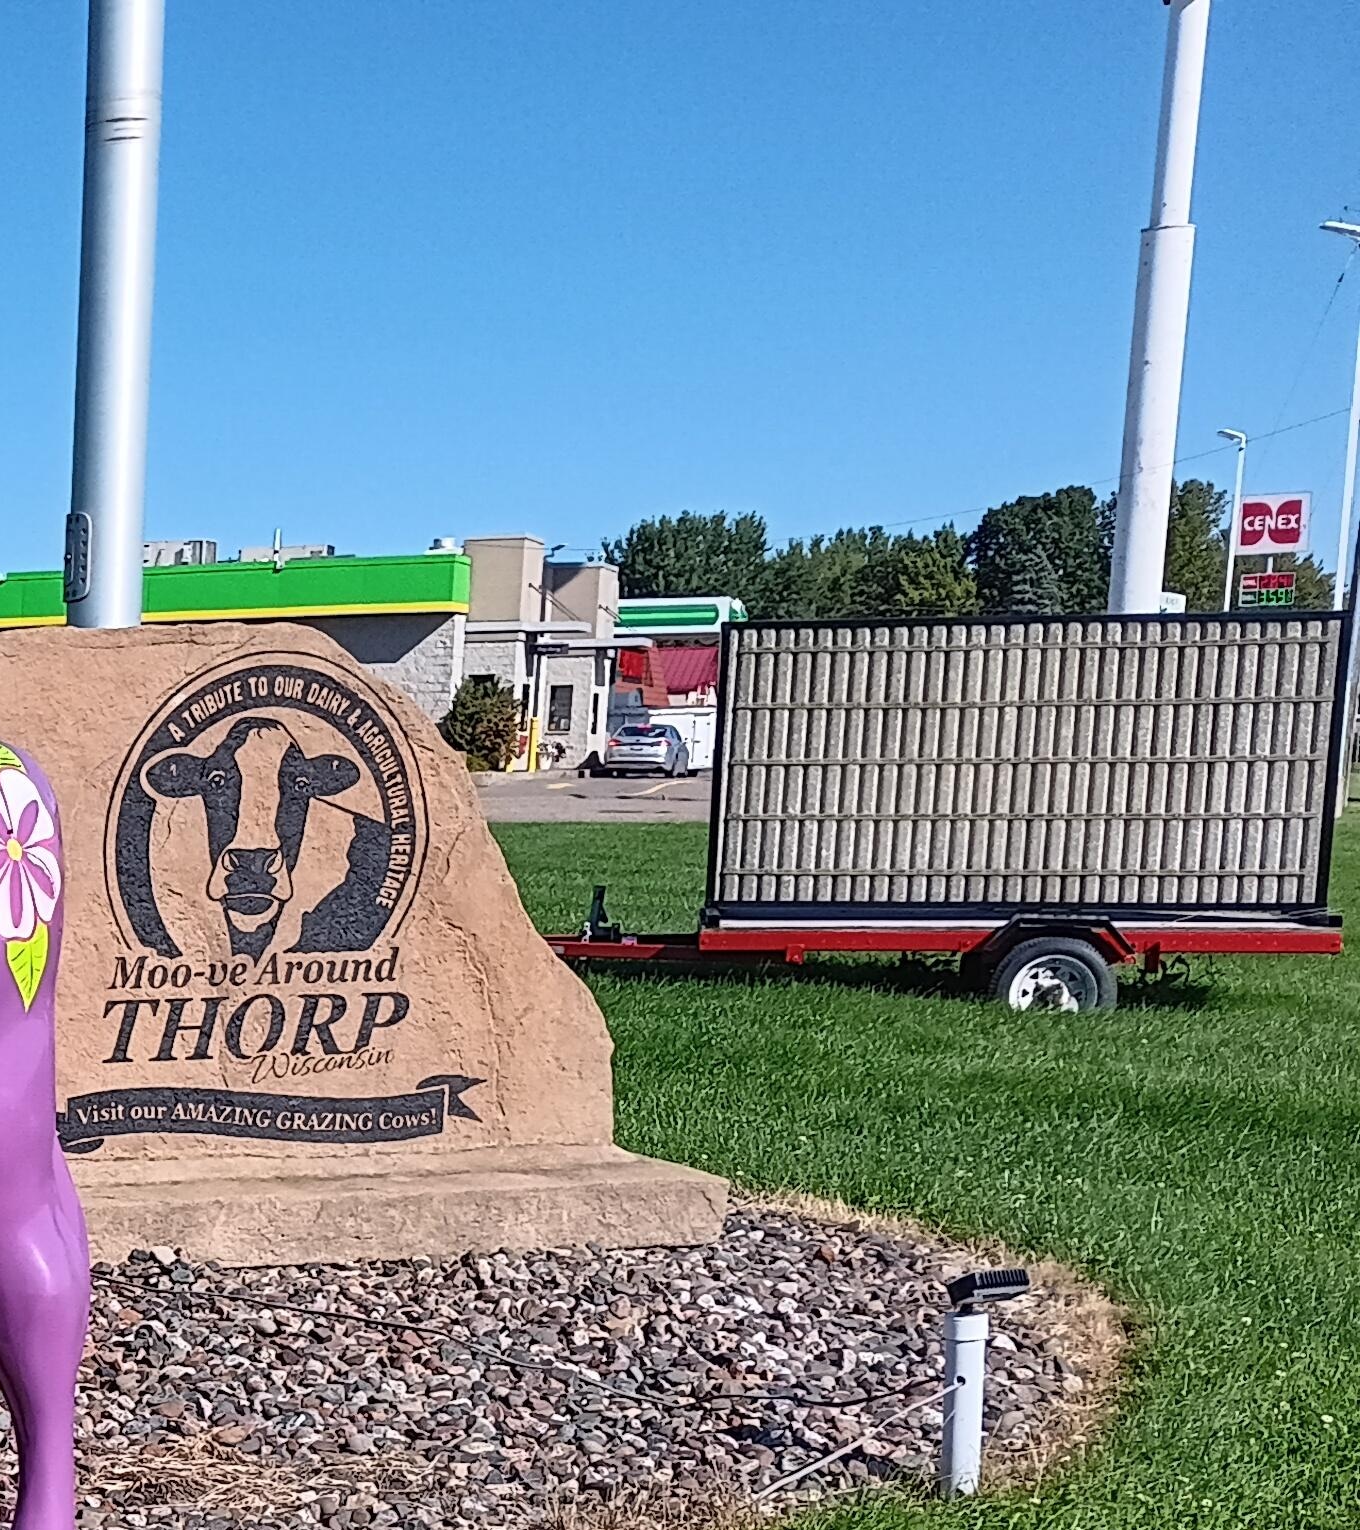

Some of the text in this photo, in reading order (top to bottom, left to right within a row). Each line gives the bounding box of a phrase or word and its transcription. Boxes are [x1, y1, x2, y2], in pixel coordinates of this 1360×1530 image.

[1243, 513, 1300, 532] CENEX
[167, 675, 412, 909] A TRIBUTE TO OUR DAIRY & AGRICULTURAL HERITAGE
[108, 946, 400, 990] Moo-ve Around
[102, 991, 411, 1064] THORP
[251, 1046, 394, 1085] Wisconsin
[76, 1103, 438, 1132] Visit our AMAZING GRAZING Cows!
